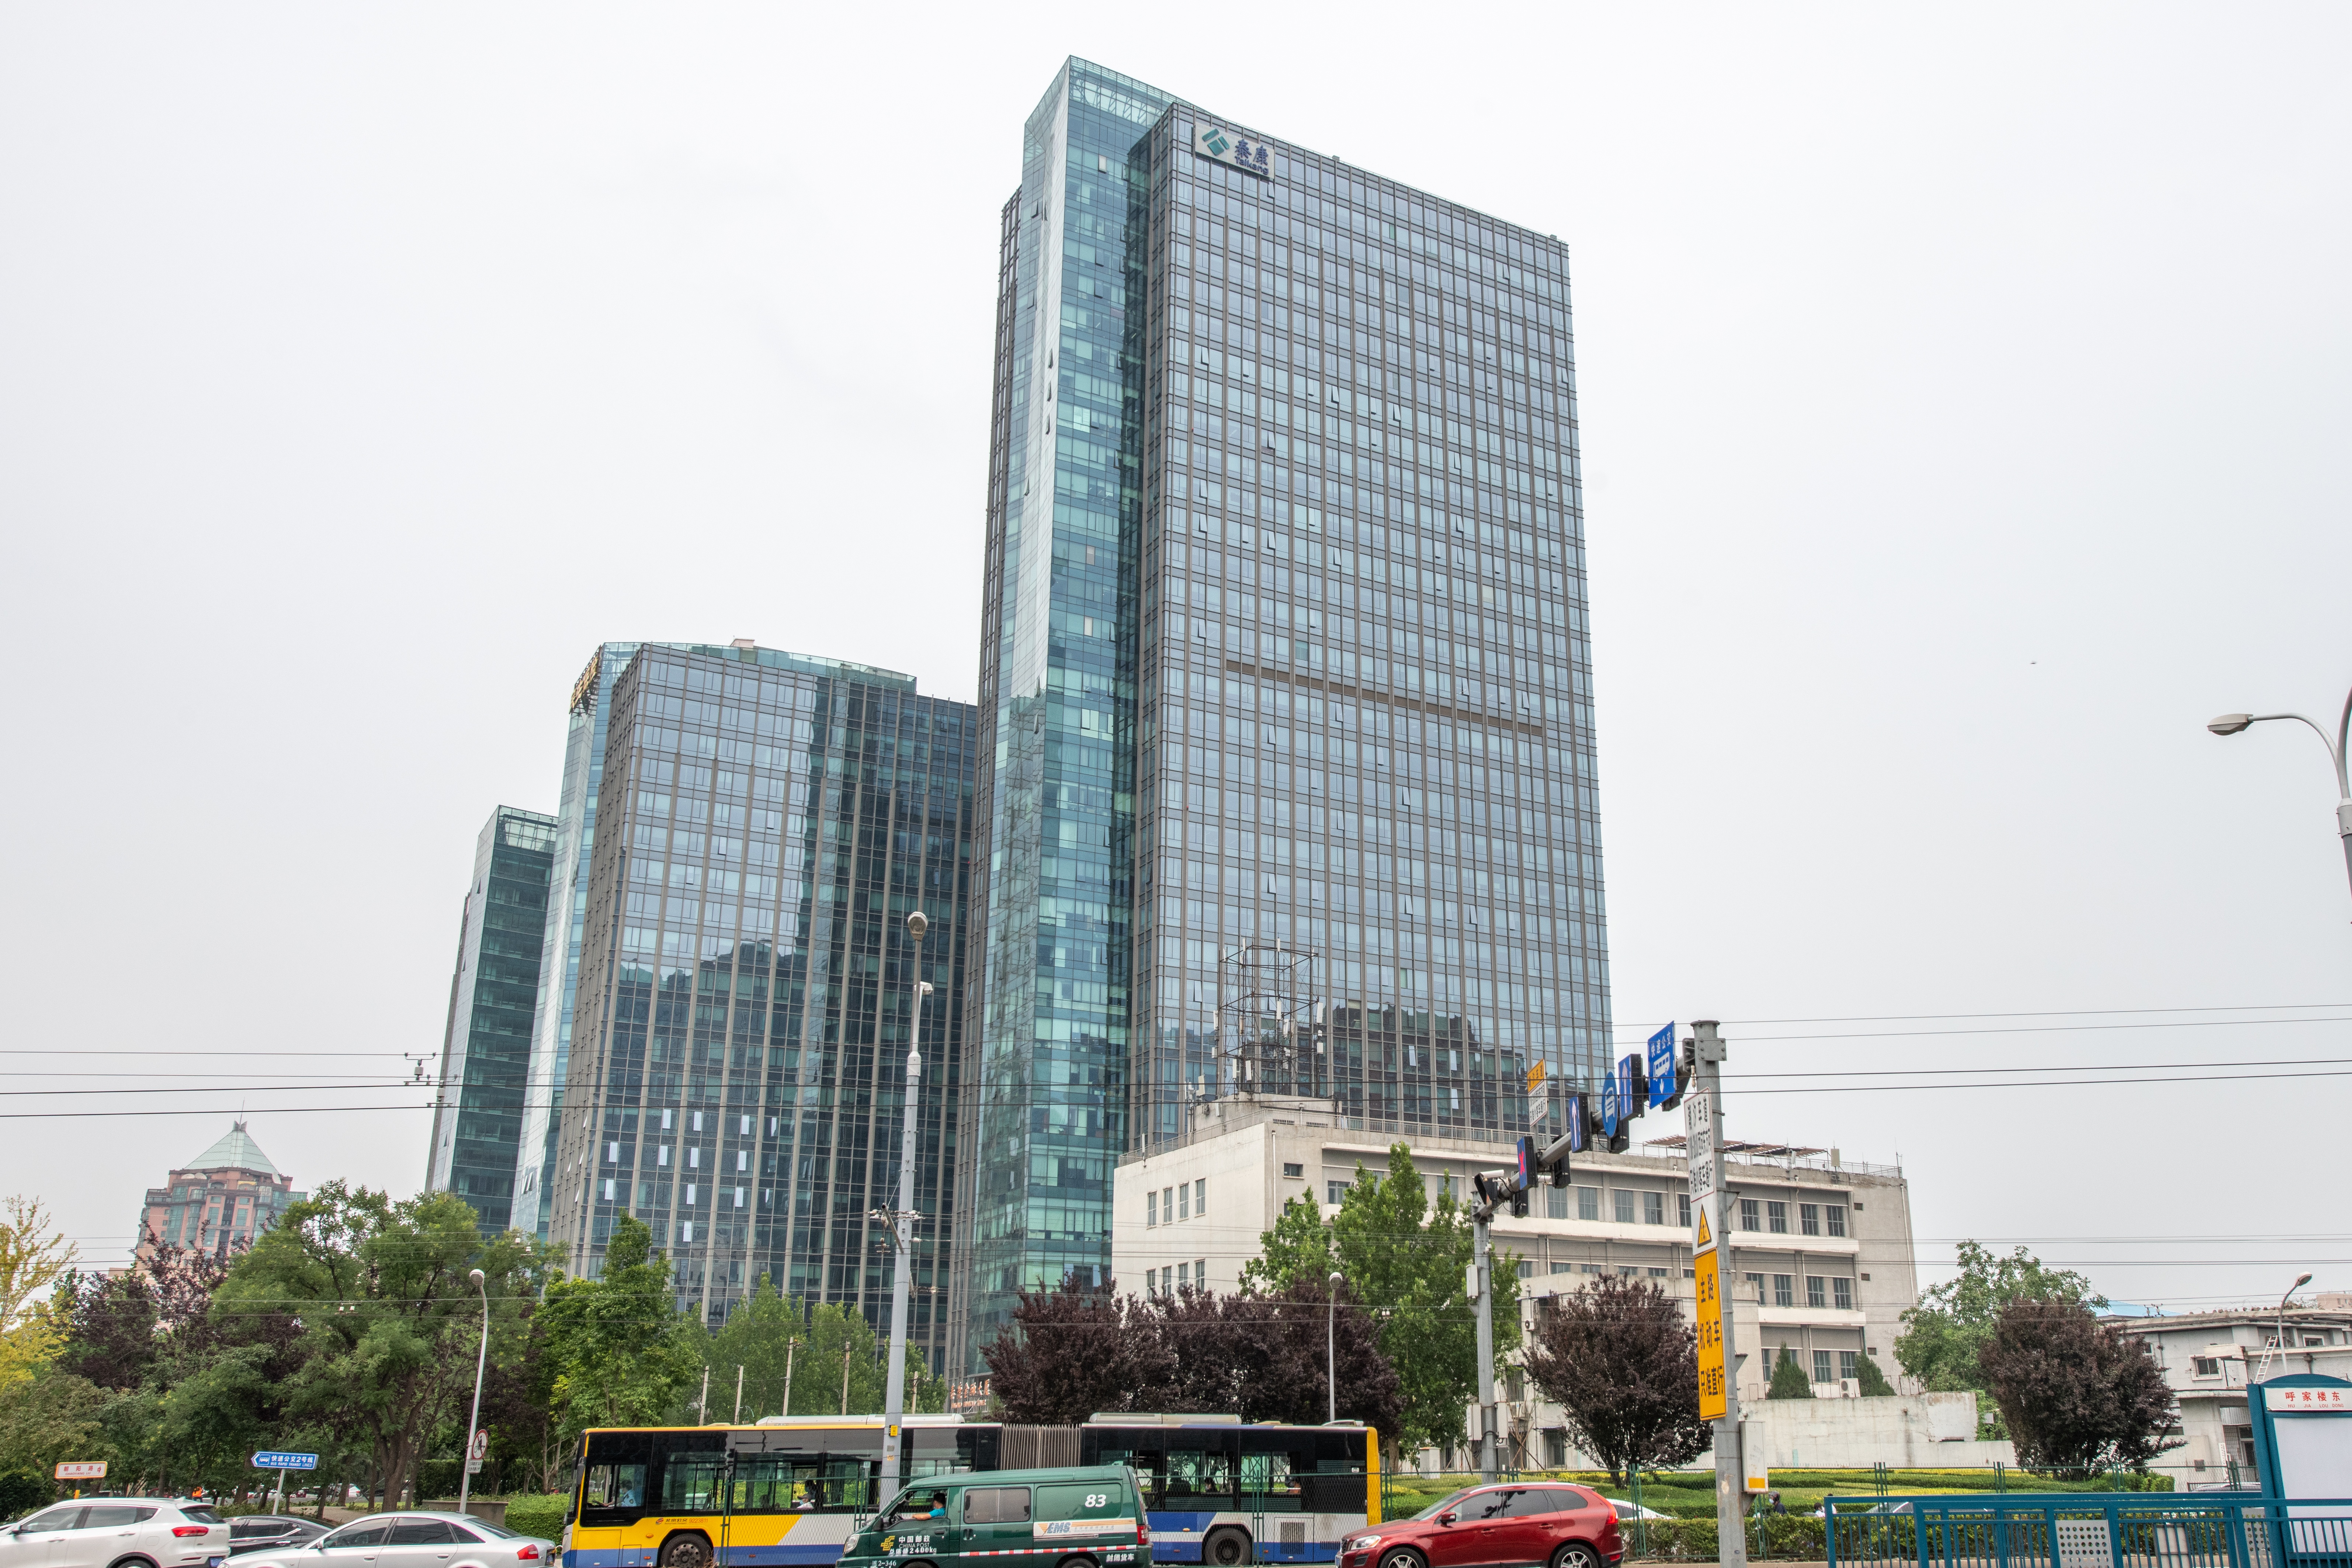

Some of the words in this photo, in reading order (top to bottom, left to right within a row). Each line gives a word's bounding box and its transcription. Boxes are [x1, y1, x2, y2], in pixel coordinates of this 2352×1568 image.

[1235, 139, 1268, 165] 泰康
[1235, 156, 1269, 175] Taikang
[1651, 1031, 1671, 1058] 快速公交
[1687, 1096, 1707, 1130] 潮汐车道
[1690, 1160, 1713, 1194] 只准小客车通行
[1700, 1272, 1714, 1303] 主路
[1700, 1317, 1720, 1350] 机动车
[1700, 1366, 1724, 1397] 只准直行
[2285, 1391, 2340, 1401] 呼家楼东
[271, 1455, 313, 1463] 快速公交2号线
[1085, 1494, 1106, 1507] 83
[899, 1535, 930, 1543] 中国邮政
[1047, 1522, 1071, 1534] EMS
[1106, 1553, 1134, 1562] 封闭货车
